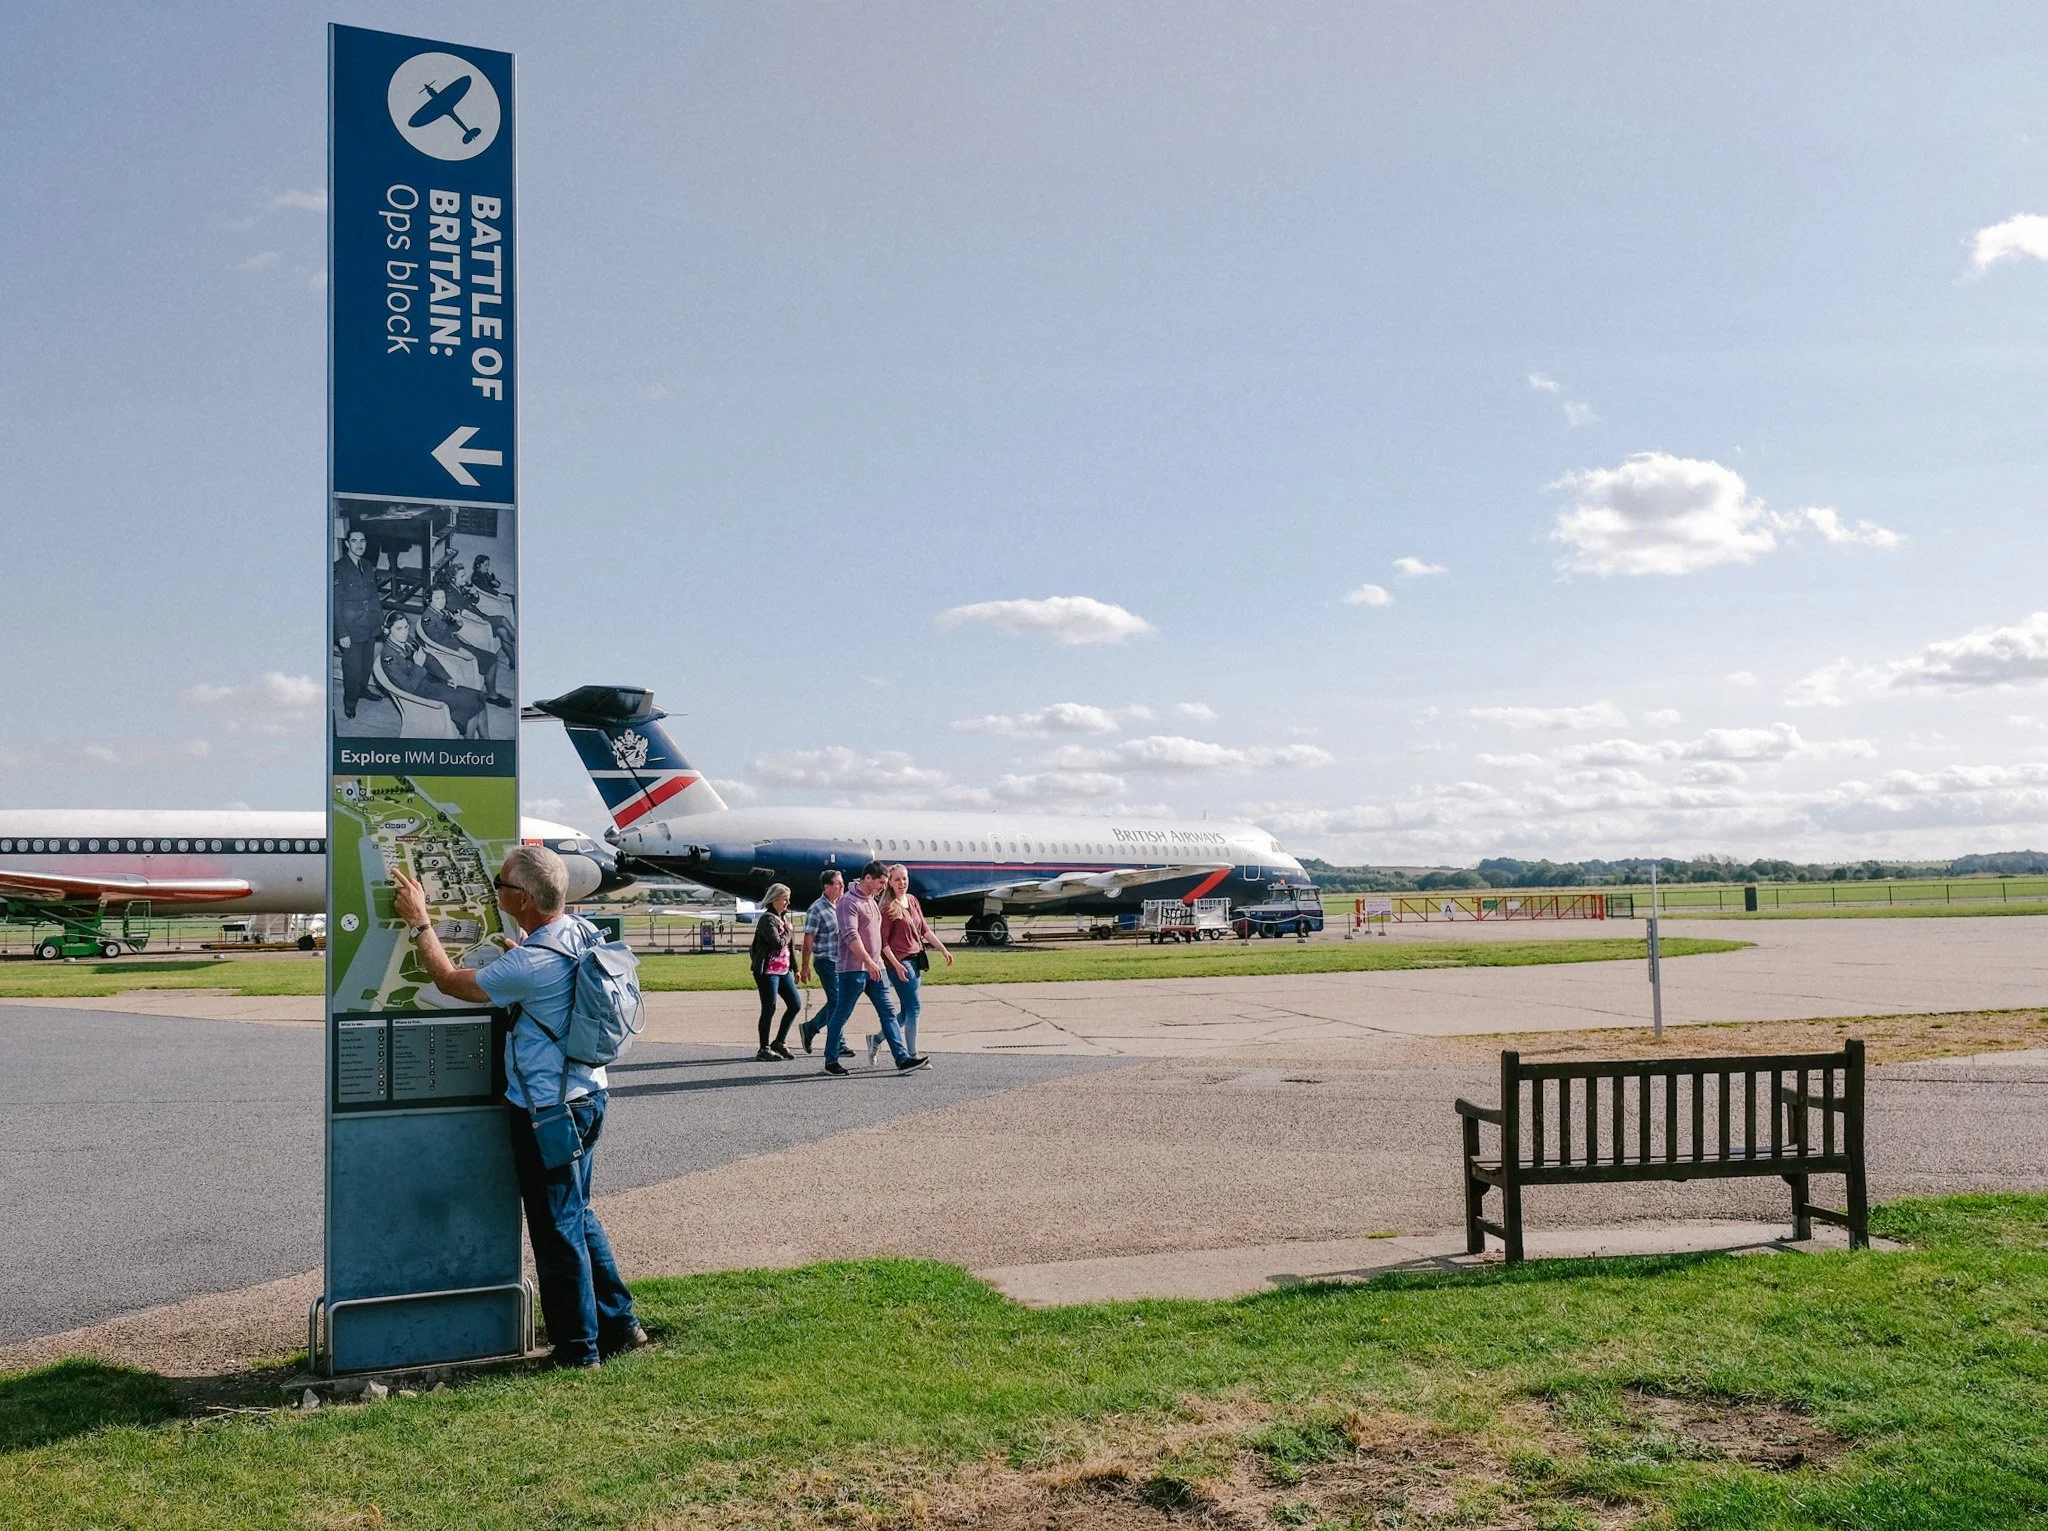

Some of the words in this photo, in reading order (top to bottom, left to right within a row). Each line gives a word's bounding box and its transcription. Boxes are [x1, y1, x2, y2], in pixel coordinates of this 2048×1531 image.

[379, 183, 420, 251] Ops
[429, 188, 462, 357] BRITAIN:
[471, 194, 502, 340] BATTLE
[386, 260, 419, 354] block
[472, 347, 503, 401] OF
[341, 750, 401, 766] Explore
[405, 751, 435, 764] IWM
[439, 752, 495, 766] Duxford
[1112, 828, 1168, 843] BRITISH
[1170, 830, 1226, 844] AIRWAYS
[1444, 904, 1452, 913] A
